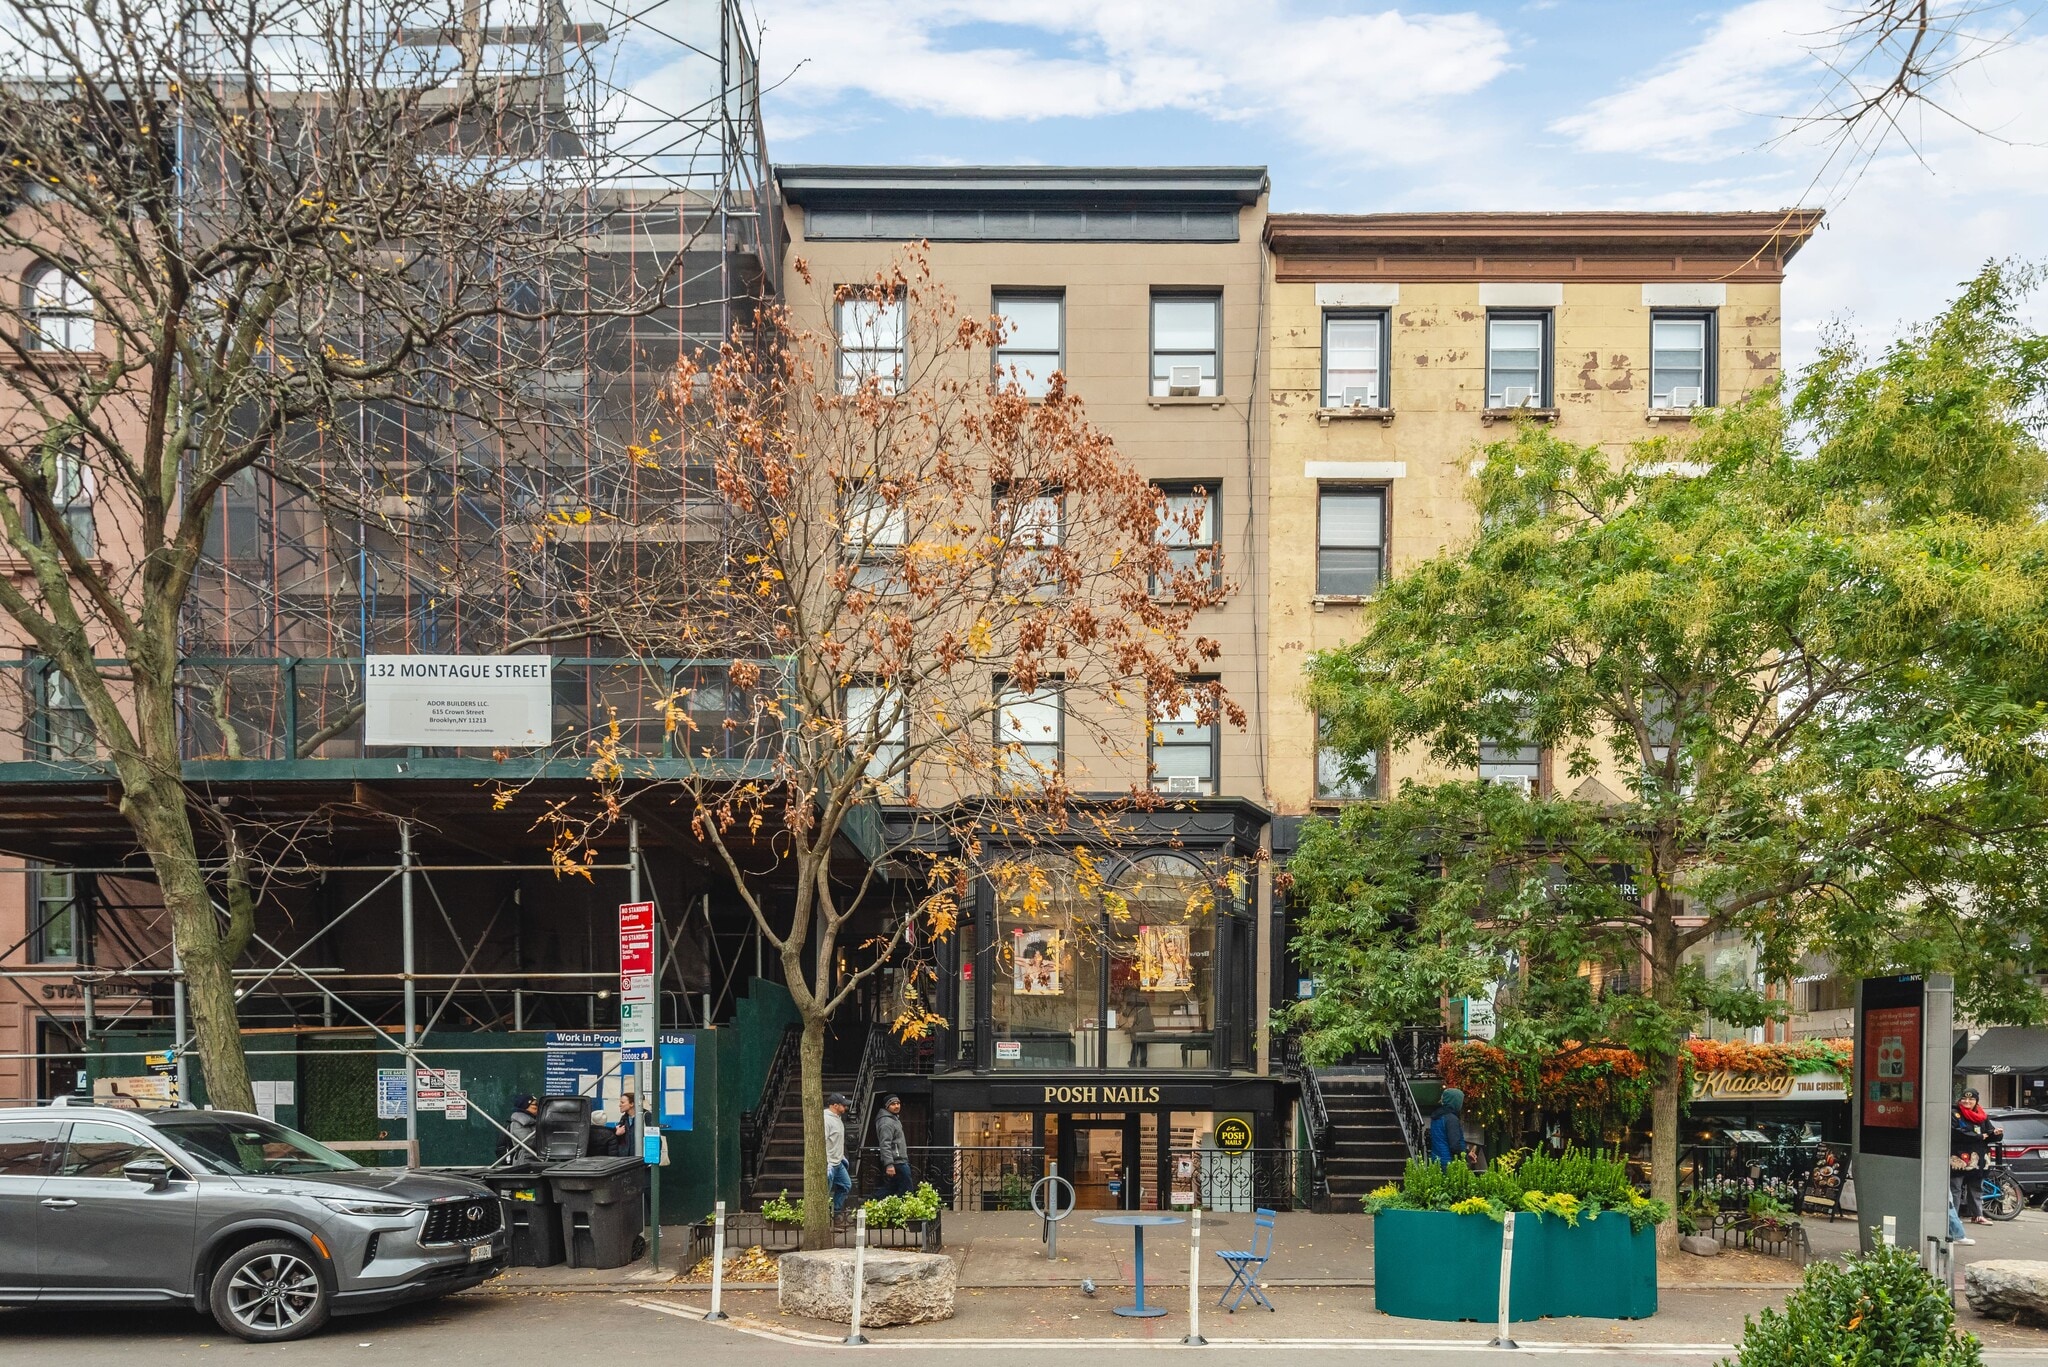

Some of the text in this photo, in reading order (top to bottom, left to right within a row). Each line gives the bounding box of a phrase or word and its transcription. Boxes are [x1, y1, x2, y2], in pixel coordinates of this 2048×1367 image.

[369, 664, 548, 678] 132 MONTAGUE STREET
[1792, 973, 1828, 983] COMPASS
[1898, 974, 1922, 983] LinkNYC
[624, 1005, 630, 1017] 2
[556, 1033, 581, 1042] Work
[594, 1034, 622, 1044] Progr
[667, 1035, 685, 1043] Use
[1692, 1071, 1845, 1099] Khaosan THAI CUISINE
[1044, 1086, 1160, 1103] POSH NAILS
[1221, 1132, 1245, 1140] POSH
